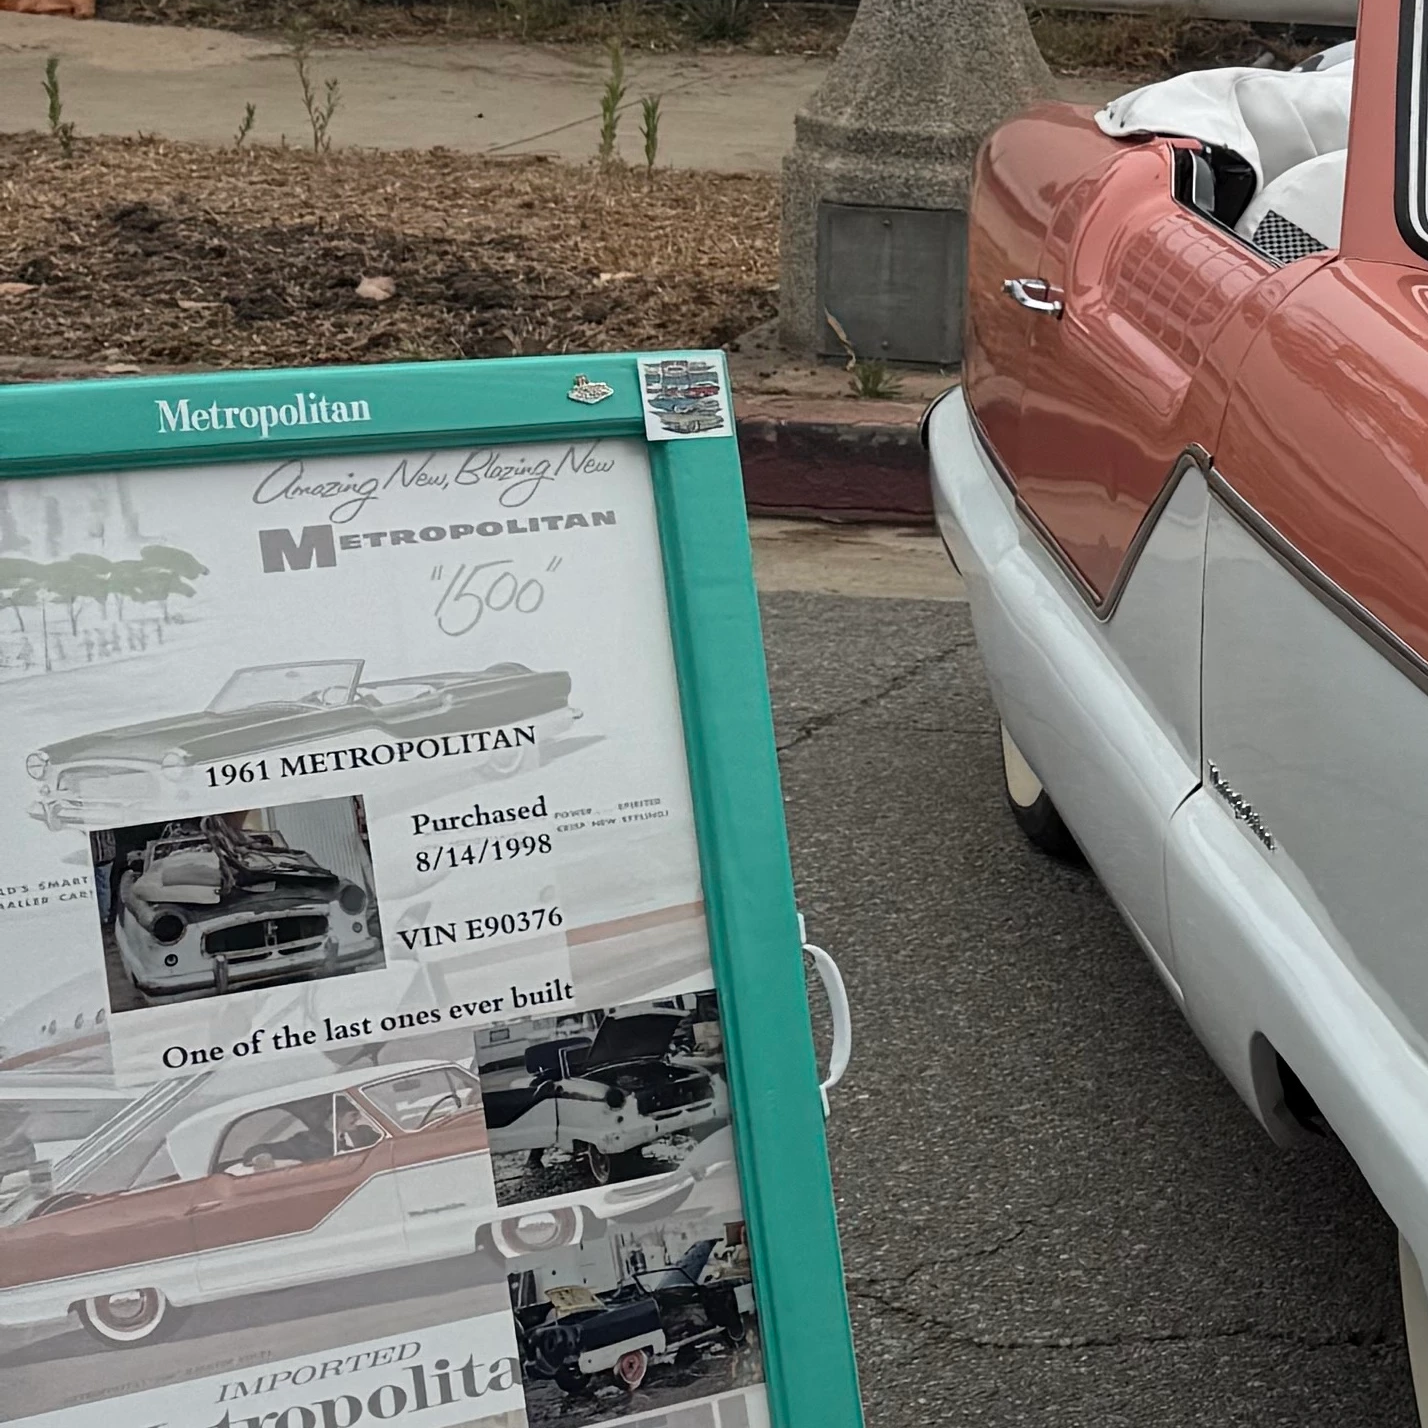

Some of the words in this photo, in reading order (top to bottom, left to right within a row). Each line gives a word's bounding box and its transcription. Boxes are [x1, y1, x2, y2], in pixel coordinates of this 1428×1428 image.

[155, 392, 372, 439] Metropolitan
[252, 456, 379, 524] Amazing
[454, 449, 556, 508] Blazing
[553, 434, 615, 477] New
[206, 764, 271, 789] 1961
[280, 726, 538, 778] METROPOLITAN
[411, 795, 549, 837] Purchased
[415, 834, 555, 873] 8/14/1998
[397, 924, 458, 953] VIN
[465, 907, 564, 941] E90376
[161, 1040, 225, 1072] One
[230, 1031, 265, 1060] of
[271, 1023, 318, 1054] the
[323, 1015, 373, 1045] last
[379, 1005, 442, 1035] ones
[448, 997, 505, 1025] ever
[511, 979, 574, 1011] built
[216, 1342, 421, 1403] IMPORTED
